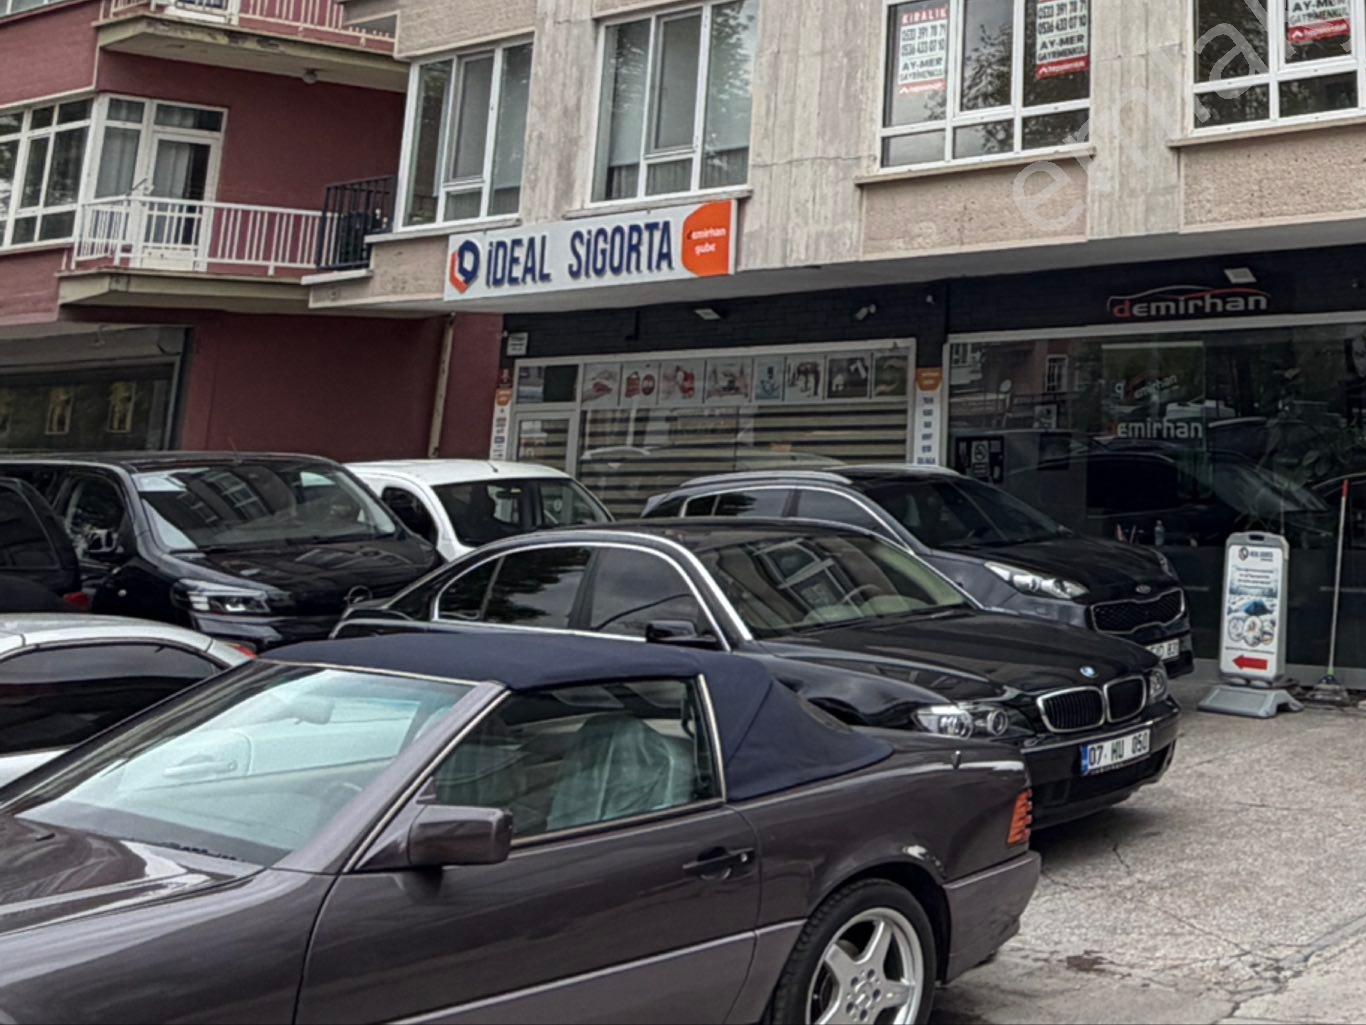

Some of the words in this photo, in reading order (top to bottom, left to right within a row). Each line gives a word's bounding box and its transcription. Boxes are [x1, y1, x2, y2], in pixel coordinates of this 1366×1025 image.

[1040, 35, 1085, 50] AY-MER
[901, 57, 943, 71] AY-MER
[1112, 293, 1268, 318] demirhan
[1089, 744, 1104, 766] 07
